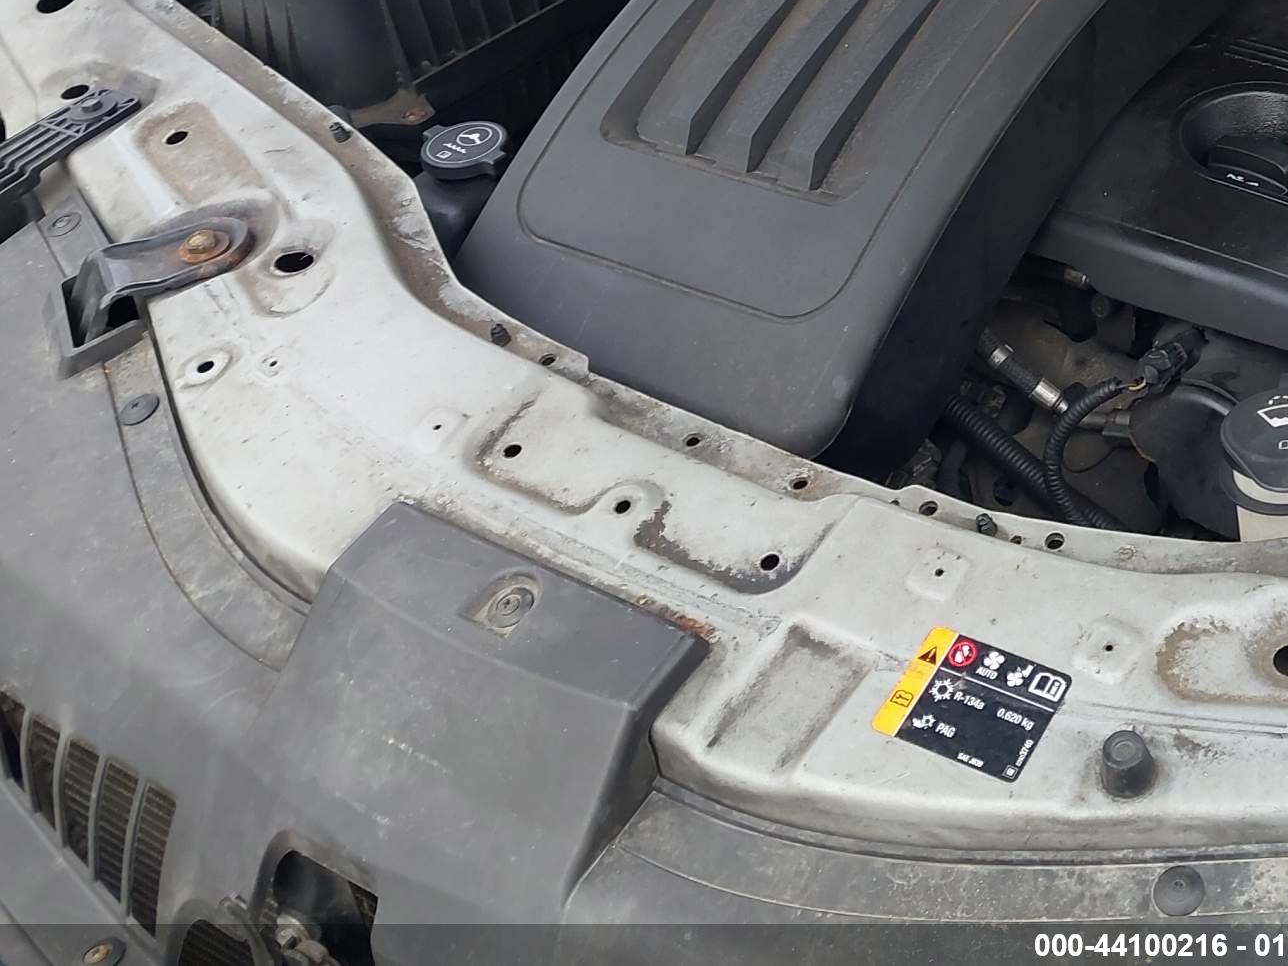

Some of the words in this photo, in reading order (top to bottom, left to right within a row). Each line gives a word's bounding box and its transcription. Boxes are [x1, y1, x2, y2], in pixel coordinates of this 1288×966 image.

[976, 667, 998, 680] AUTO
[953, 690, 985, 710] R-134a
[996, 707, 1022, 724] 0.620
[1021, 717, 1035, 731] kg
[935, 722, 956, 739] PAG
